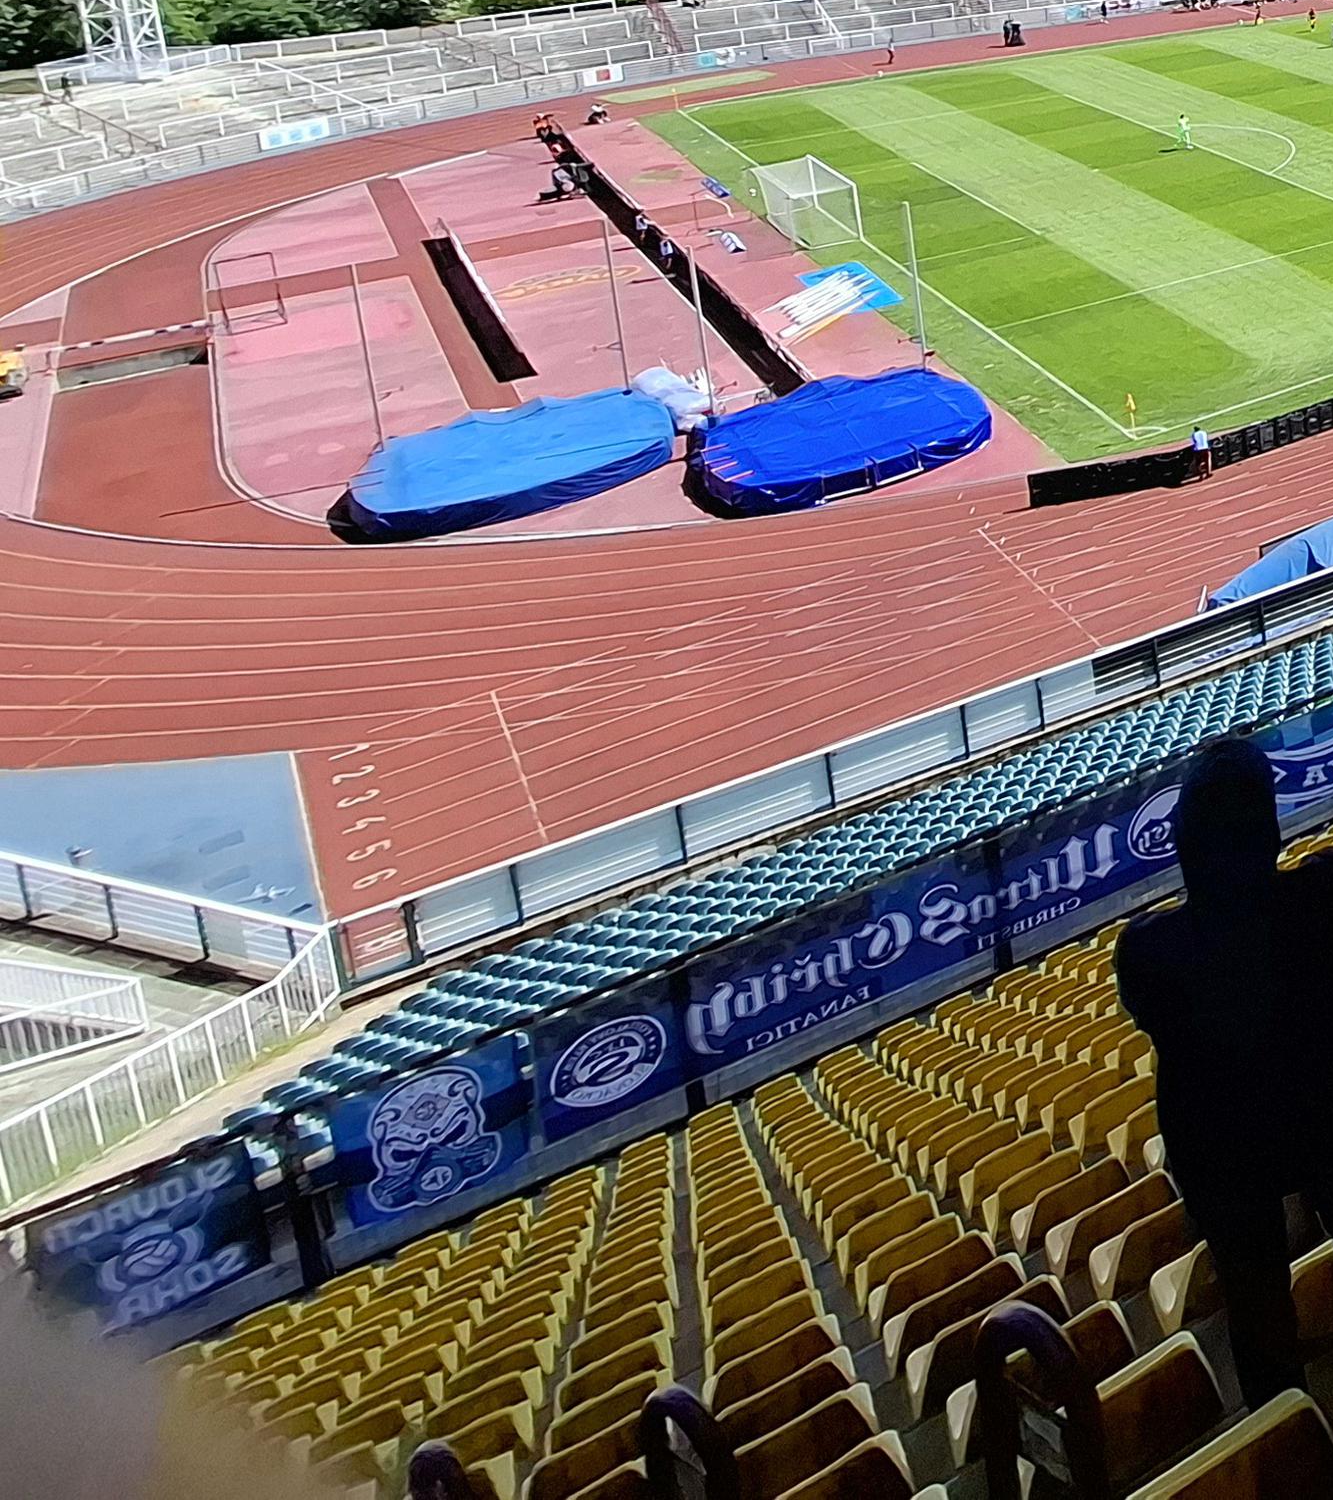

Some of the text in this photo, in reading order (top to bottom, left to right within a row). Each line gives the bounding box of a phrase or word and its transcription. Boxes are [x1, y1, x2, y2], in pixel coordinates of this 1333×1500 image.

[331, 764, 376, 786] 2
[336, 788, 381, 809] 3
[341, 815, 387, 835] 4
[346, 839, 392, 862] 5
[352, 867, 398, 891] 6
